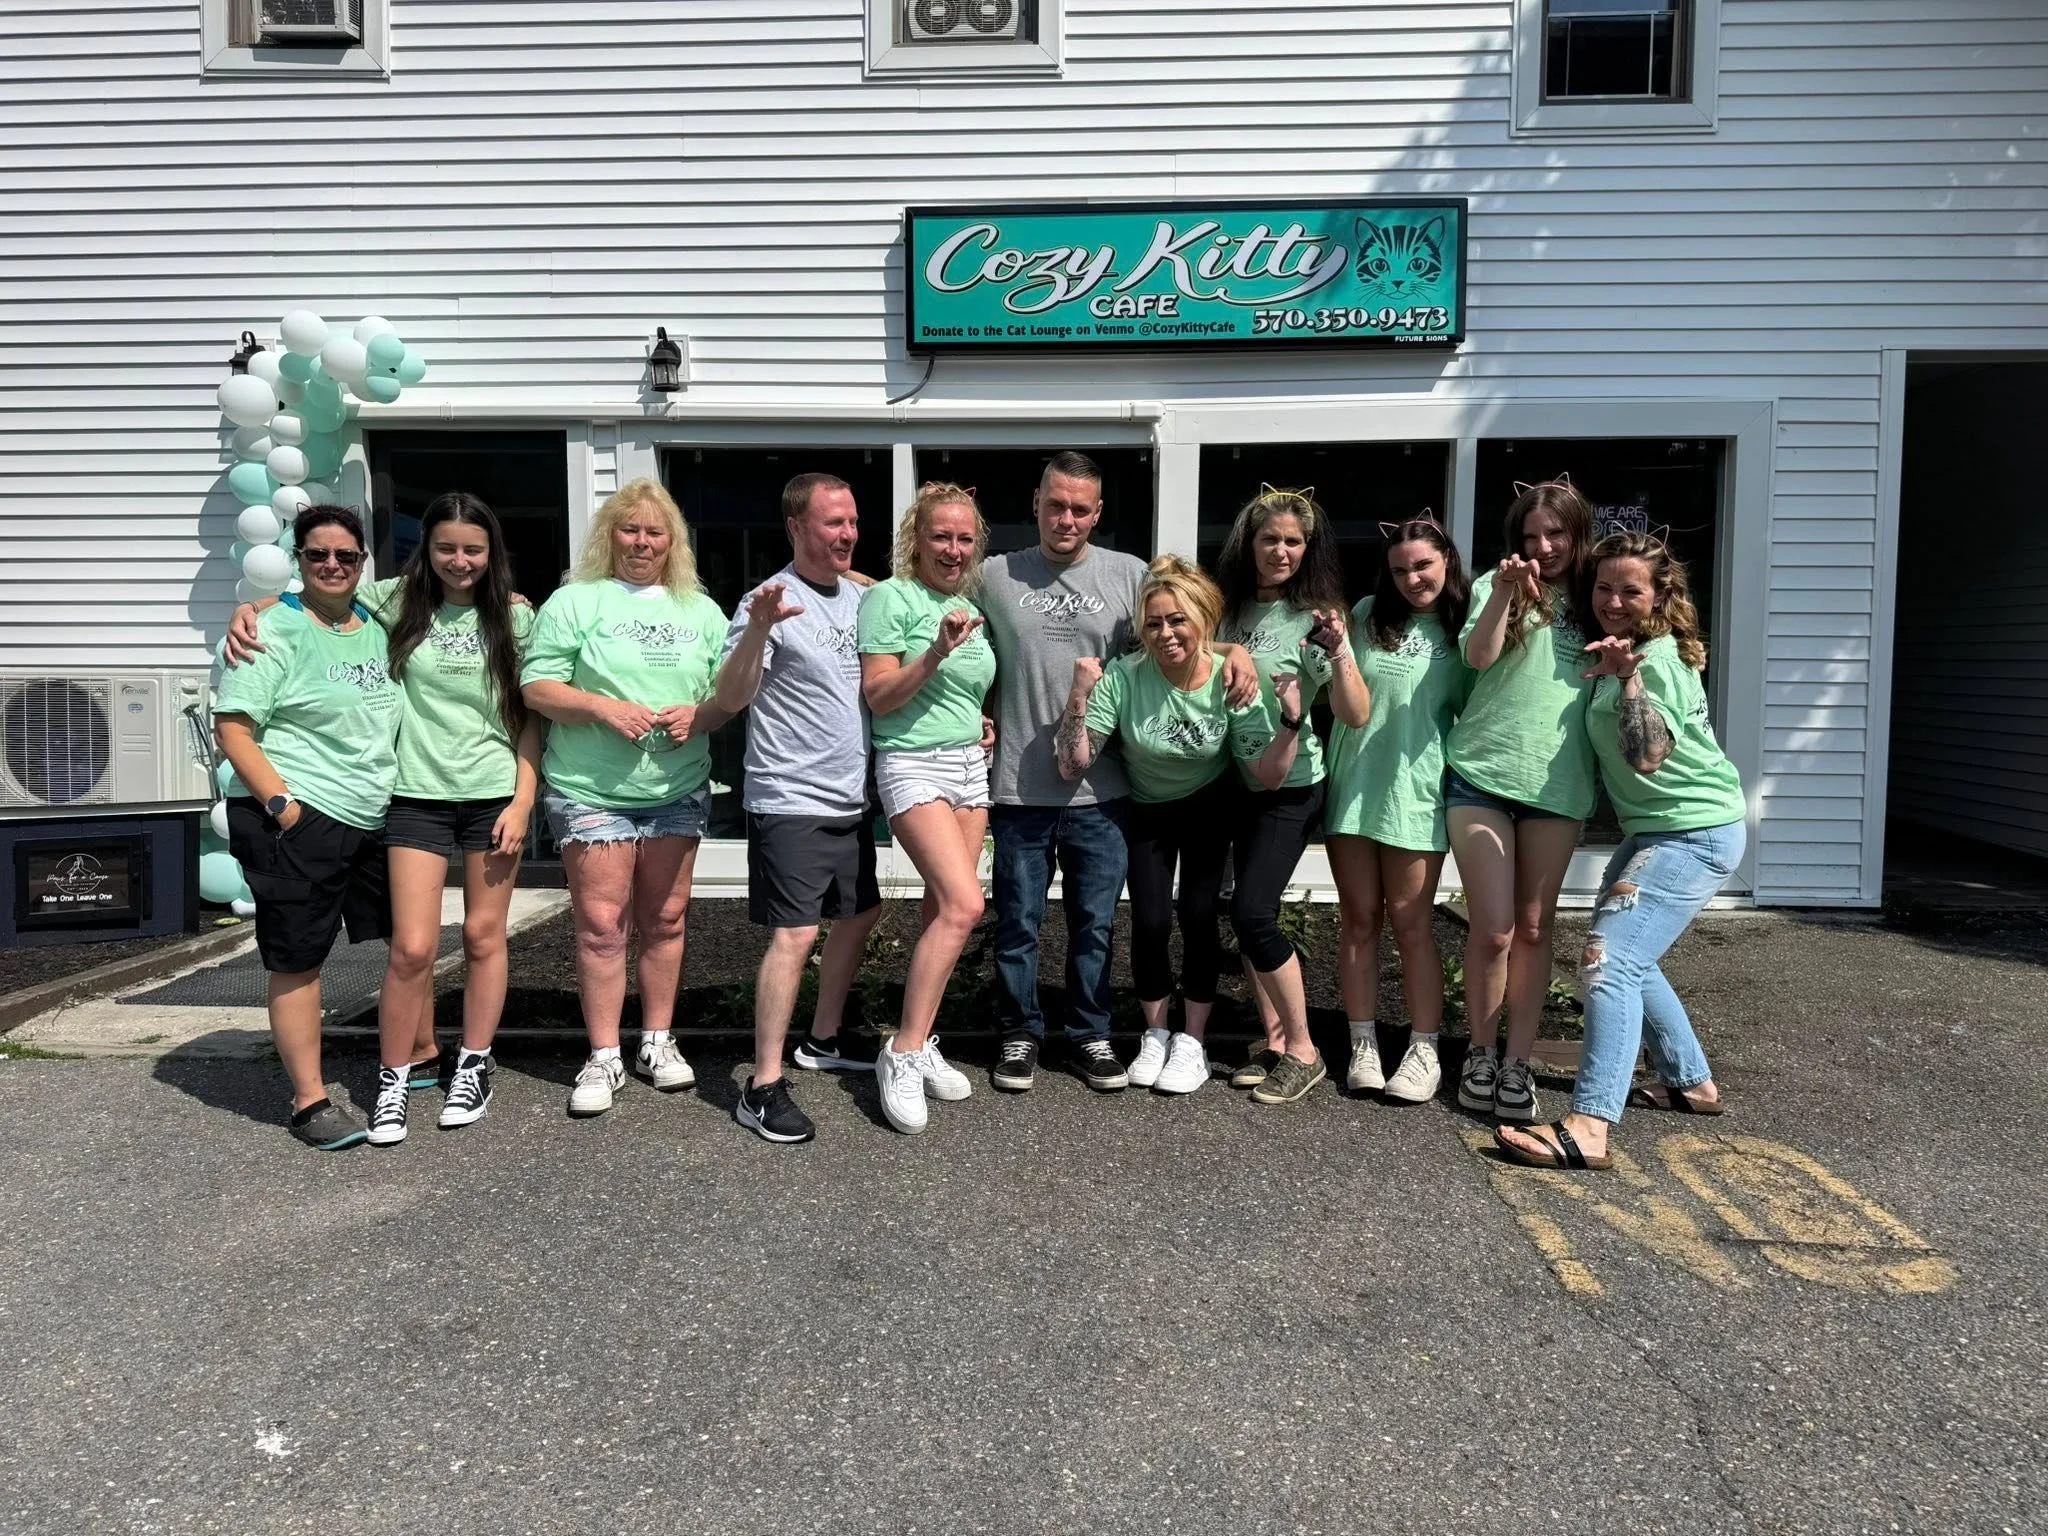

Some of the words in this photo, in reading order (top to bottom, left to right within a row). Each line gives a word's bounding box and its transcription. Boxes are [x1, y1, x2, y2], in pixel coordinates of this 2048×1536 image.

[924, 222, 1119, 312] Cozy
[1112, 220, 1348, 305] Kitty
[1089, 293, 1179, 318] CAFE
[922, 325, 963, 337] Donate
[967, 326, 980, 336] to
[983, 325, 1002, 336] the
[1007, 325, 1026, 336] Cat
[1030, 324, 1072, 338] Lounge
[1076, 326, 1090, 335] on
[1095, 324, 1134, 335] Venmo
[1139, 322, 1235, 337] @CozyKittyCafe
[1252, 307, 1448, 333] 570.350.9473
[1593, 506, 1615, 519] WE
[1616, 505, 1644, 519] ARE
[1019, 591, 1057, 613] Cozy
[1057, 593, 1105, 615] Kitty
[42, 895, 57, 903] Take
[60, 894, 74, 902] One
[77, 894, 97, 902] Leave
